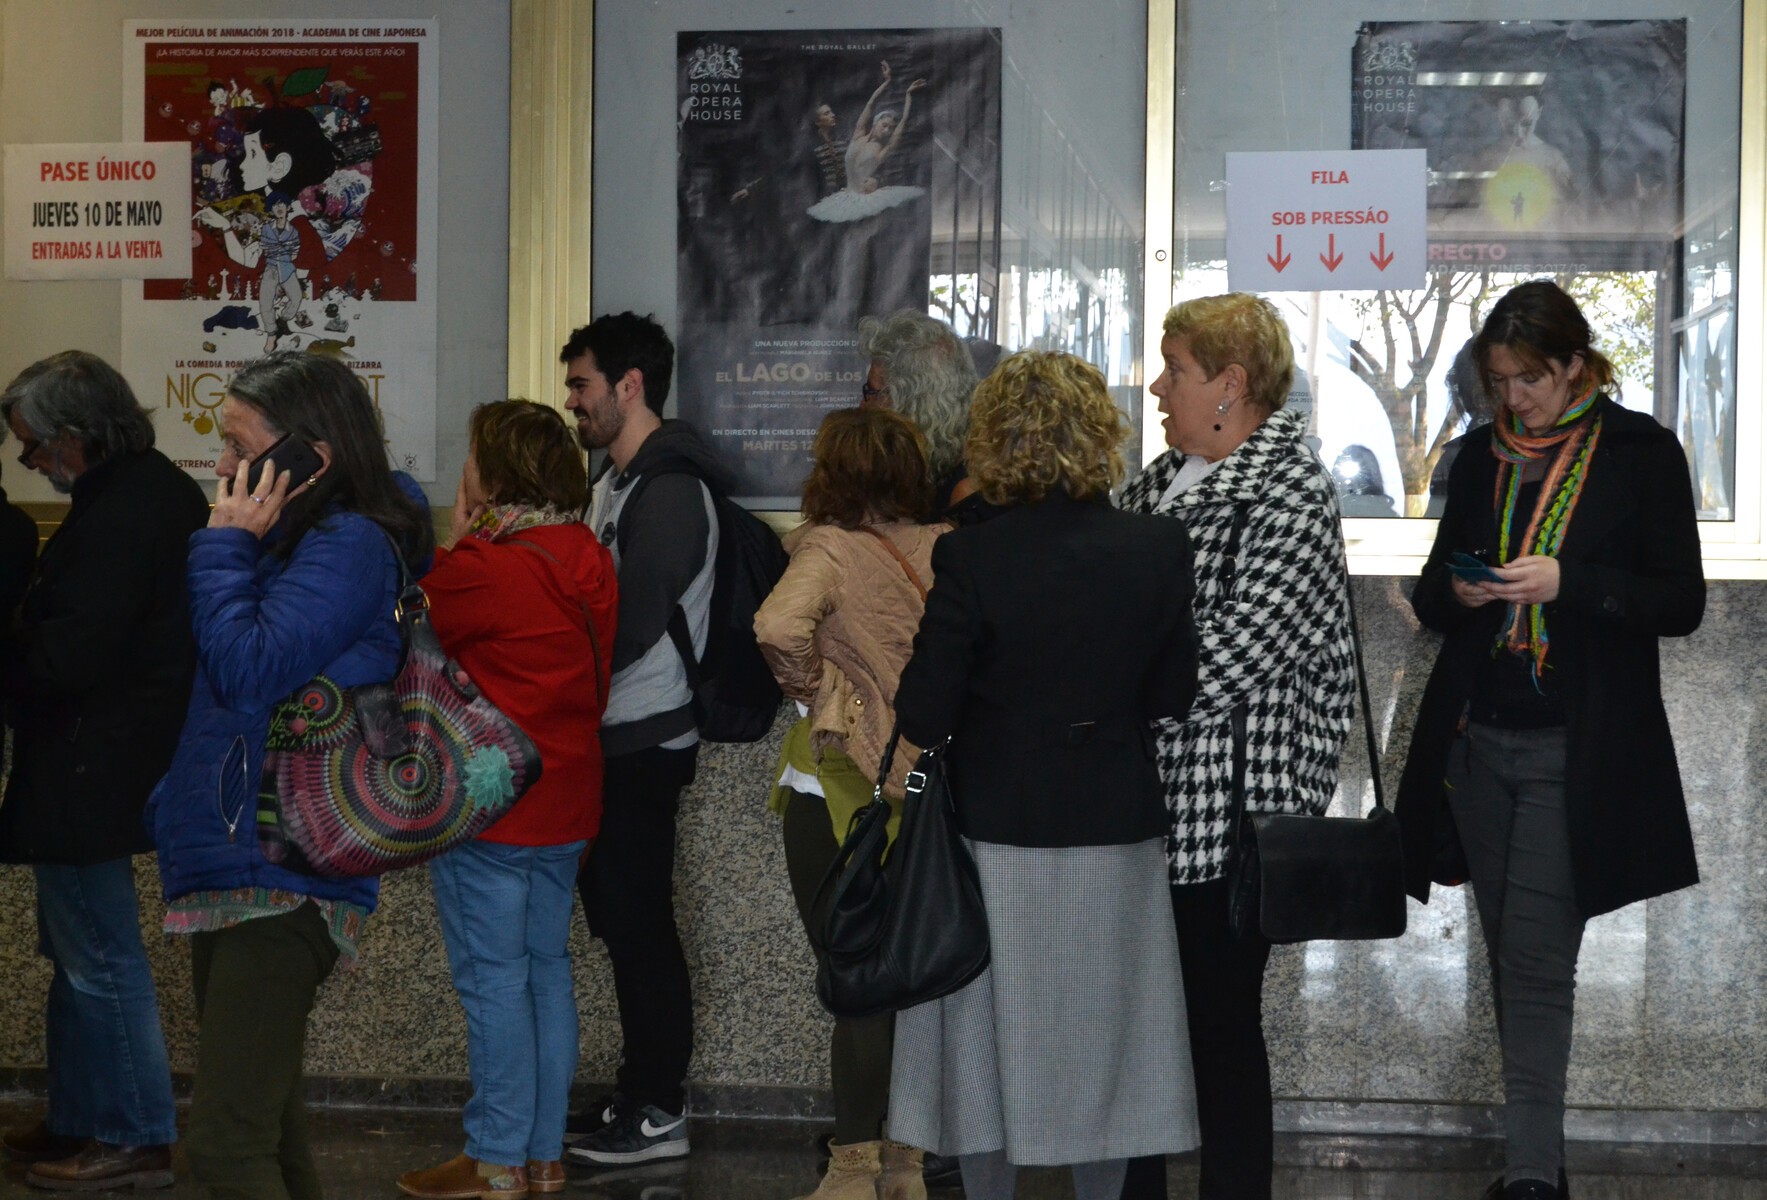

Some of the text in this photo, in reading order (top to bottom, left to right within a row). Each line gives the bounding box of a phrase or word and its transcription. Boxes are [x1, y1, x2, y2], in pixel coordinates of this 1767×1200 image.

[136, 28, 164, 37] MEJOR
[167, 26, 205, 37] PELÍCULA
[207, 28, 218, 37] DE
[220, 26, 269, 37] ANIMACIÓN
[272, 28, 295, 37] 2018
[302, 28, 347, 37] ACADEMIA
[349, 28, 360, 37] DE
[362, 28, 381, 37] CINE
[383, 28, 427, 37] JAPONESA
[169, 49, 204, 57] HISTORIA
[205, 49, 215, 57] DE
[217, 49, 241, 57] AMOR
[243, 47, 260, 57] MÁS
[262, 49, 319, 57] SORPRENDENTE
[320, 49, 338, 57] QUE
[340, 47, 364, 57] VERÁS
[365, 49, 382, 57] ESTE
[383, 47, 406, 57] AÑO!
[1363, 75, 1417, 86] ROYAL
[690, 83, 741, 93] ROYAL
[1362, 88, 1416, 100] OPERA
[689, 95, 742, 107] OPERA
[1363, 102, 1416, 113] HOUSE
[690, 110, 742, 121] HOUSE
[41, 156, 156, 182] PASE ÚNICO
[1311, 171, 1349, 184] FILA
[32, 200, 162, 228] JUEVES 10 DE MAYO
[1272, 207, 1389, 225] SOB PRESSÁO
[32, 240, 162, 260] ENTRADAS A LA VENTA
[1428, 244, 1507, 261] RECTO
[754, 340, 771, 348] UNA
[773, 340, 798, 348] NUEVA
[715, 362, 862, 382] EL LAGO DE LOS
[743, 440, 798, 451] MARTES
